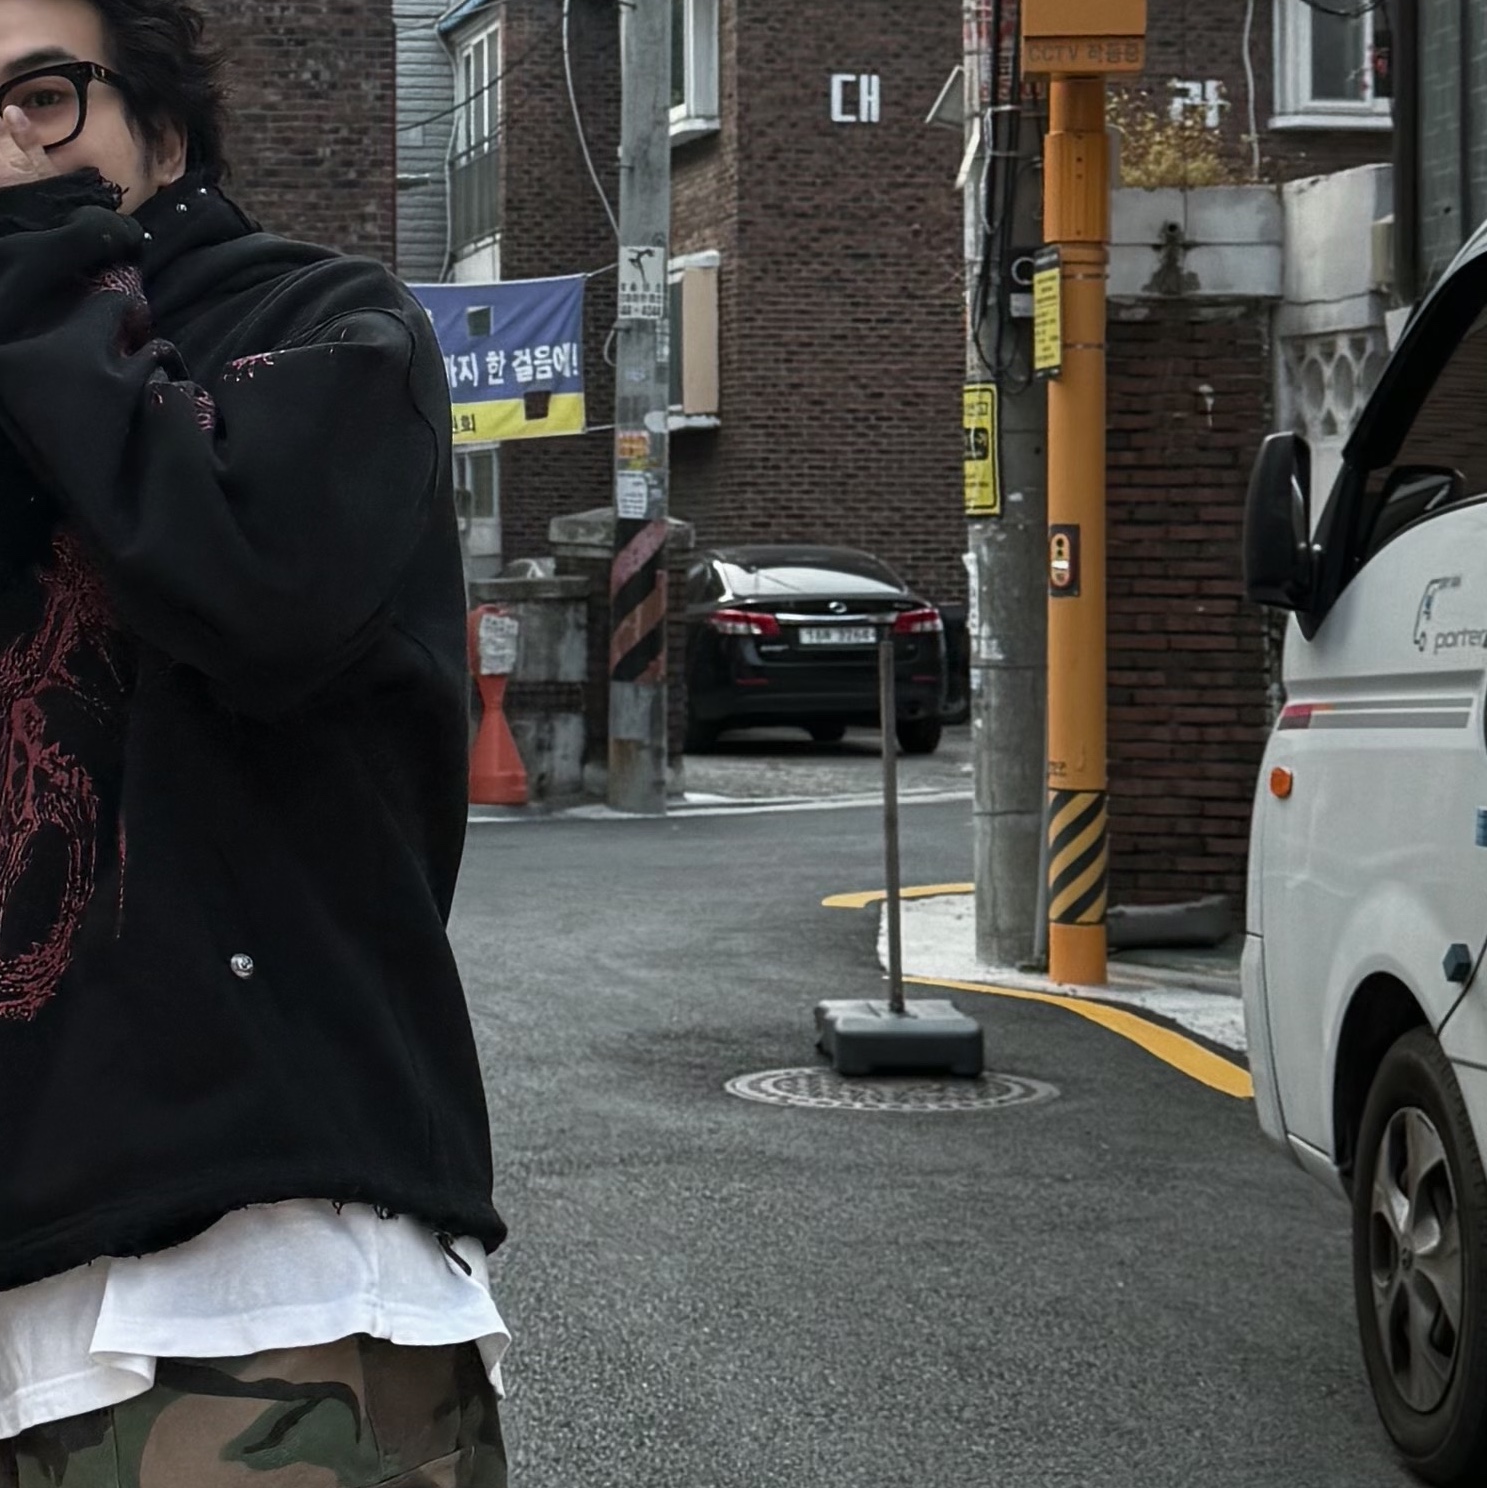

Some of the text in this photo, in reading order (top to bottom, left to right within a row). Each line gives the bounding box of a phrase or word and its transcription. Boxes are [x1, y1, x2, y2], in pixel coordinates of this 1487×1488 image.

[1028, 44, 1079, 63] CCTV
[831, 73, 880, 122] 대
[486, 350, 507, 386] 한
[512, 342, 579, 383] 걸음에!
